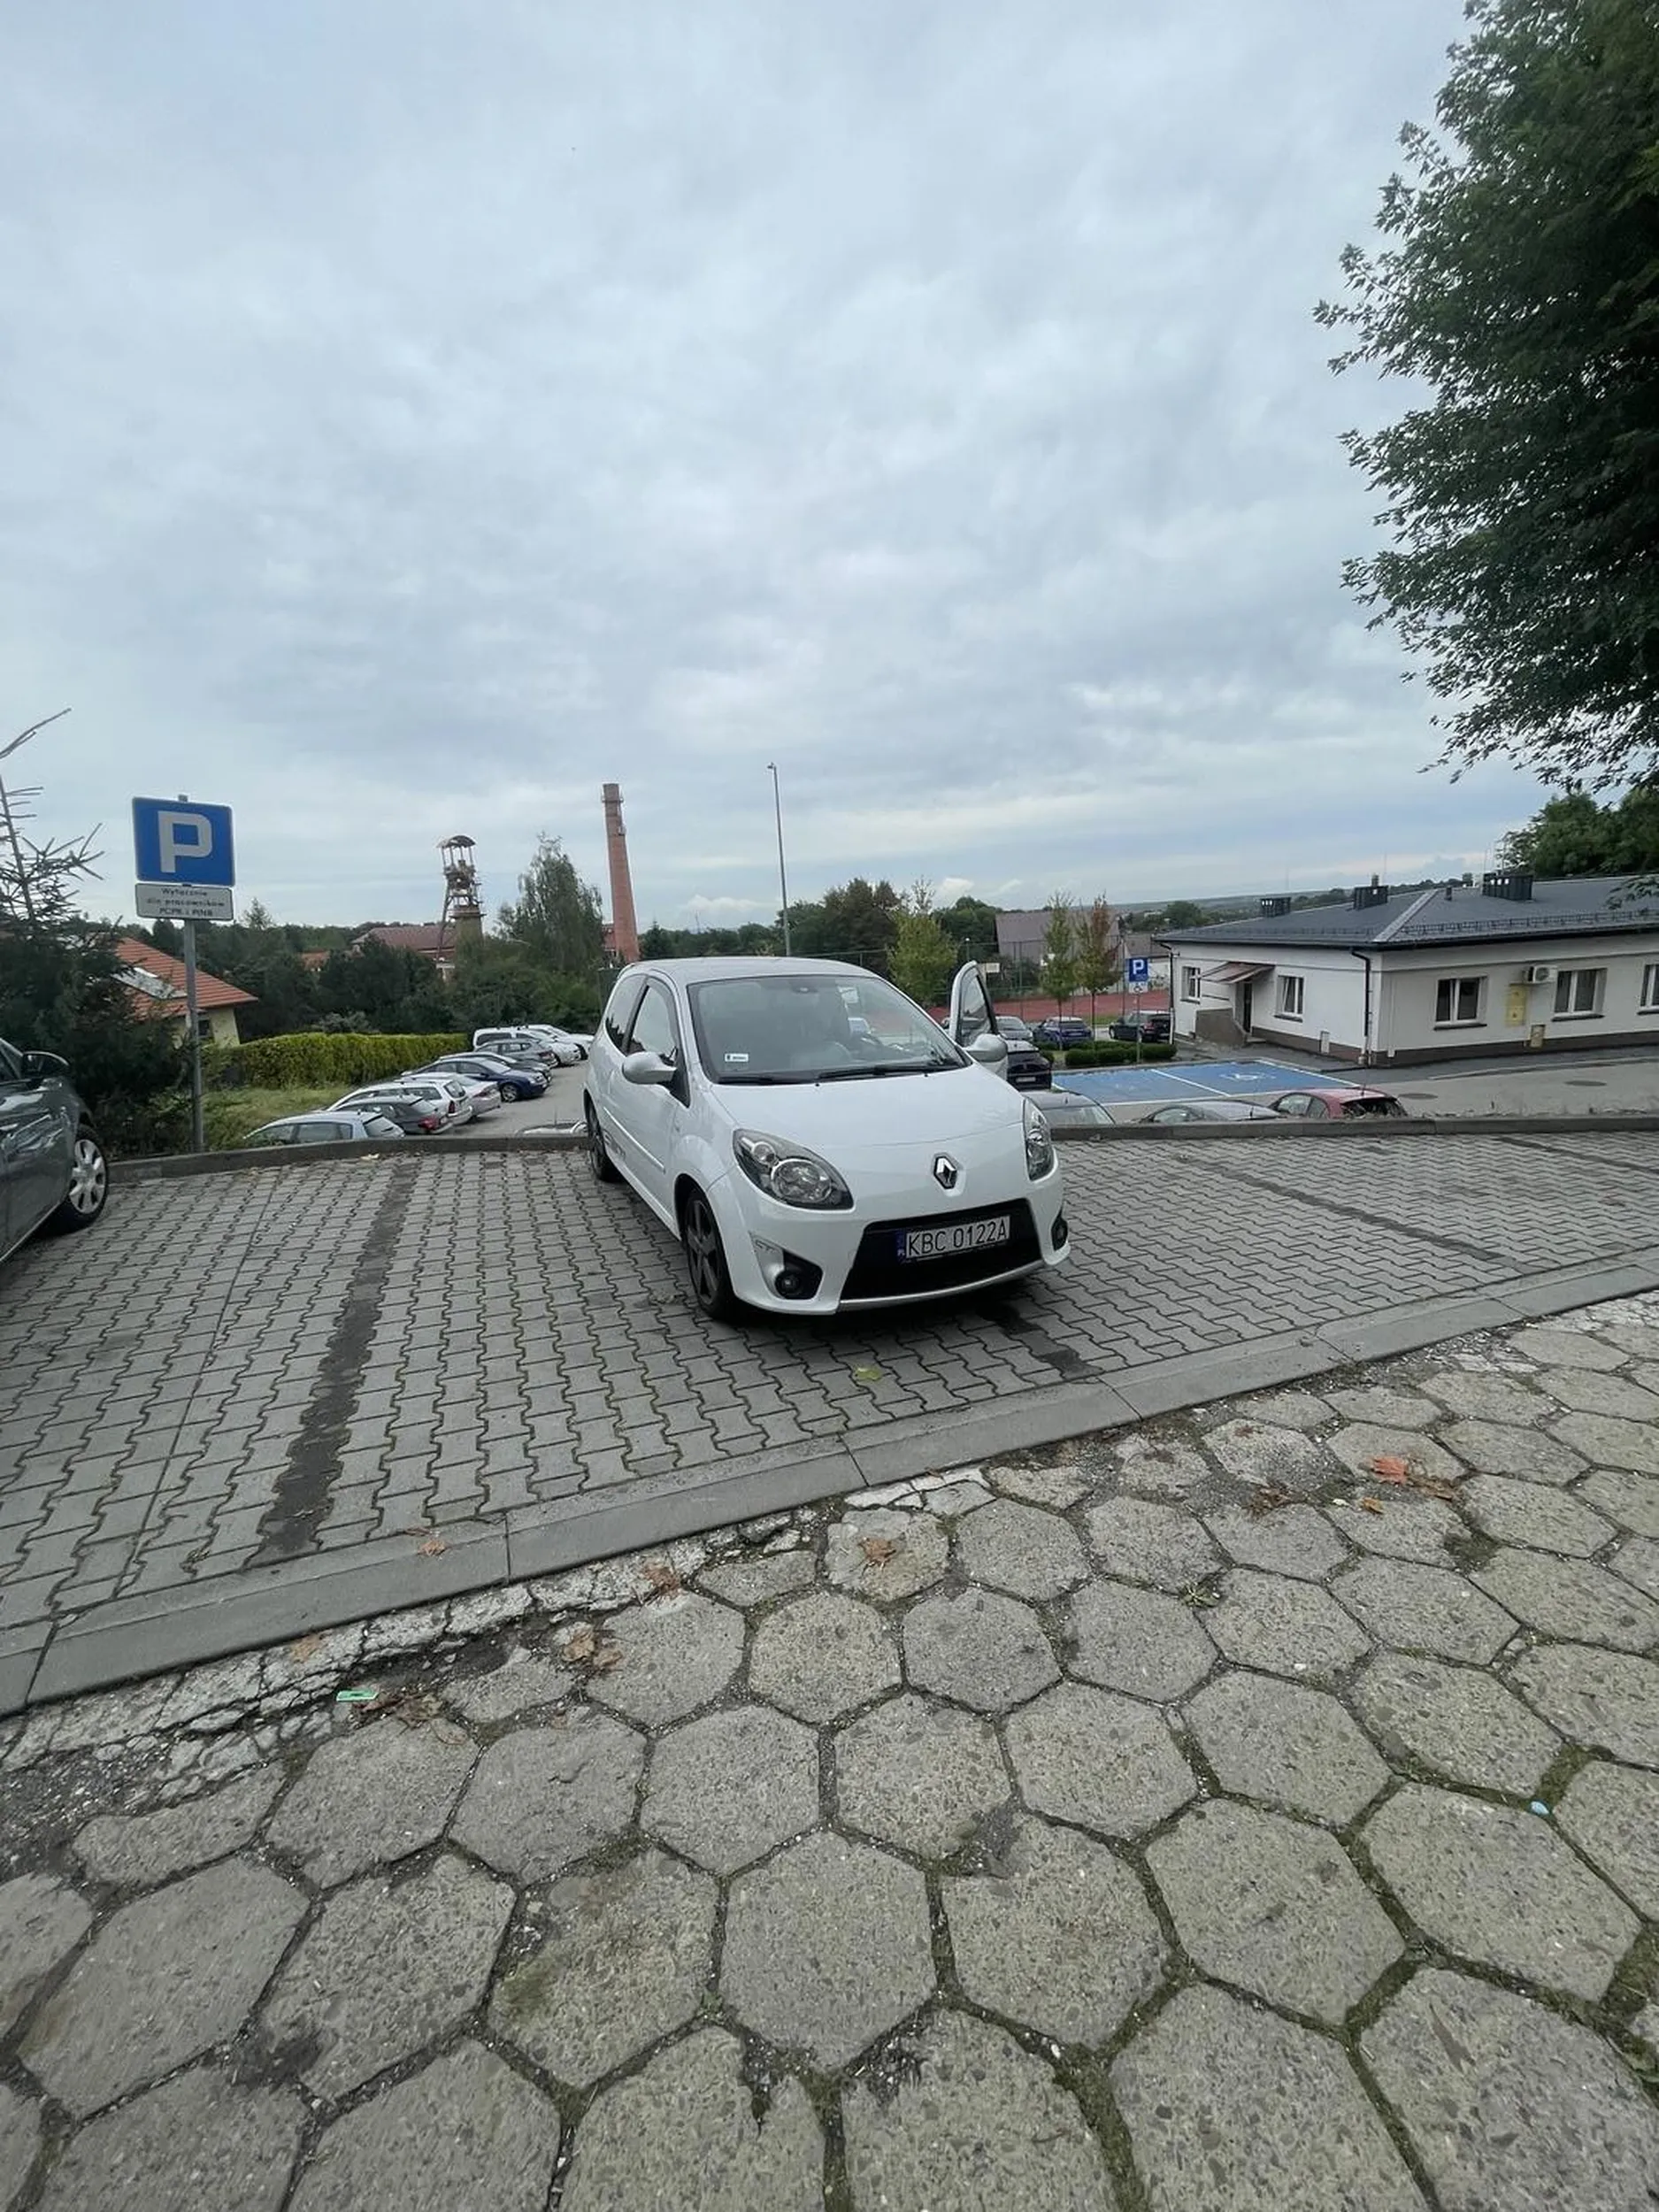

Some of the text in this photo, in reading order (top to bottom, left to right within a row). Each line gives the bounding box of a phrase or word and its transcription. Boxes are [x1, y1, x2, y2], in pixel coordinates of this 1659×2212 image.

[157, 810, 212, 873] P
[1133, 959, 1144, 974] P
[909, 1219, 1007, 1256] KBC 0122A
